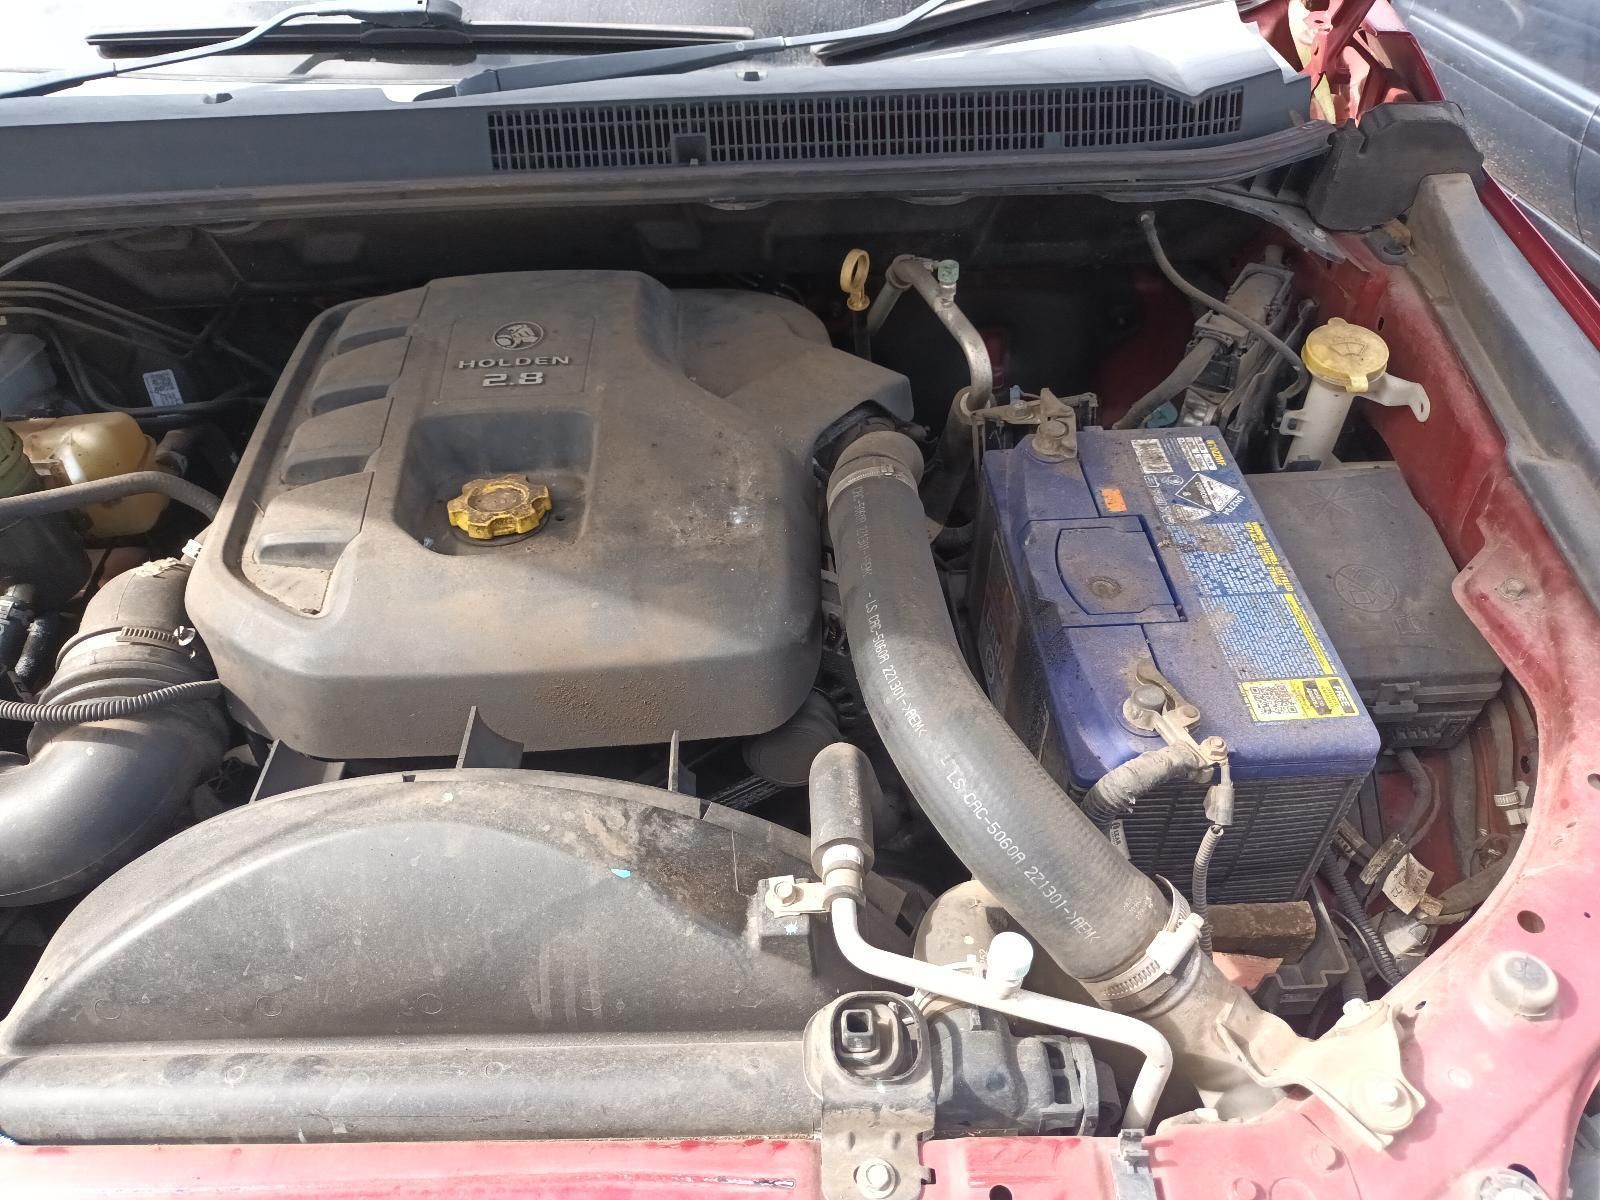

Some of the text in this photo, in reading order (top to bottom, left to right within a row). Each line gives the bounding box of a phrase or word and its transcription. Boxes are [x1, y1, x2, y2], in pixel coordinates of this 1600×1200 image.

[458, 355, 570, 369] HOLDEN
[482, 371, 544, 387] 2.8
[866, 600, 877, 613] LS
[868, 614, 889, 664] CAC-5060A
[1333, 685, 1350, 708] FREE
[947, 767, 966, 789] LS
[963, 792, 1026, 864] CAC-5060A
